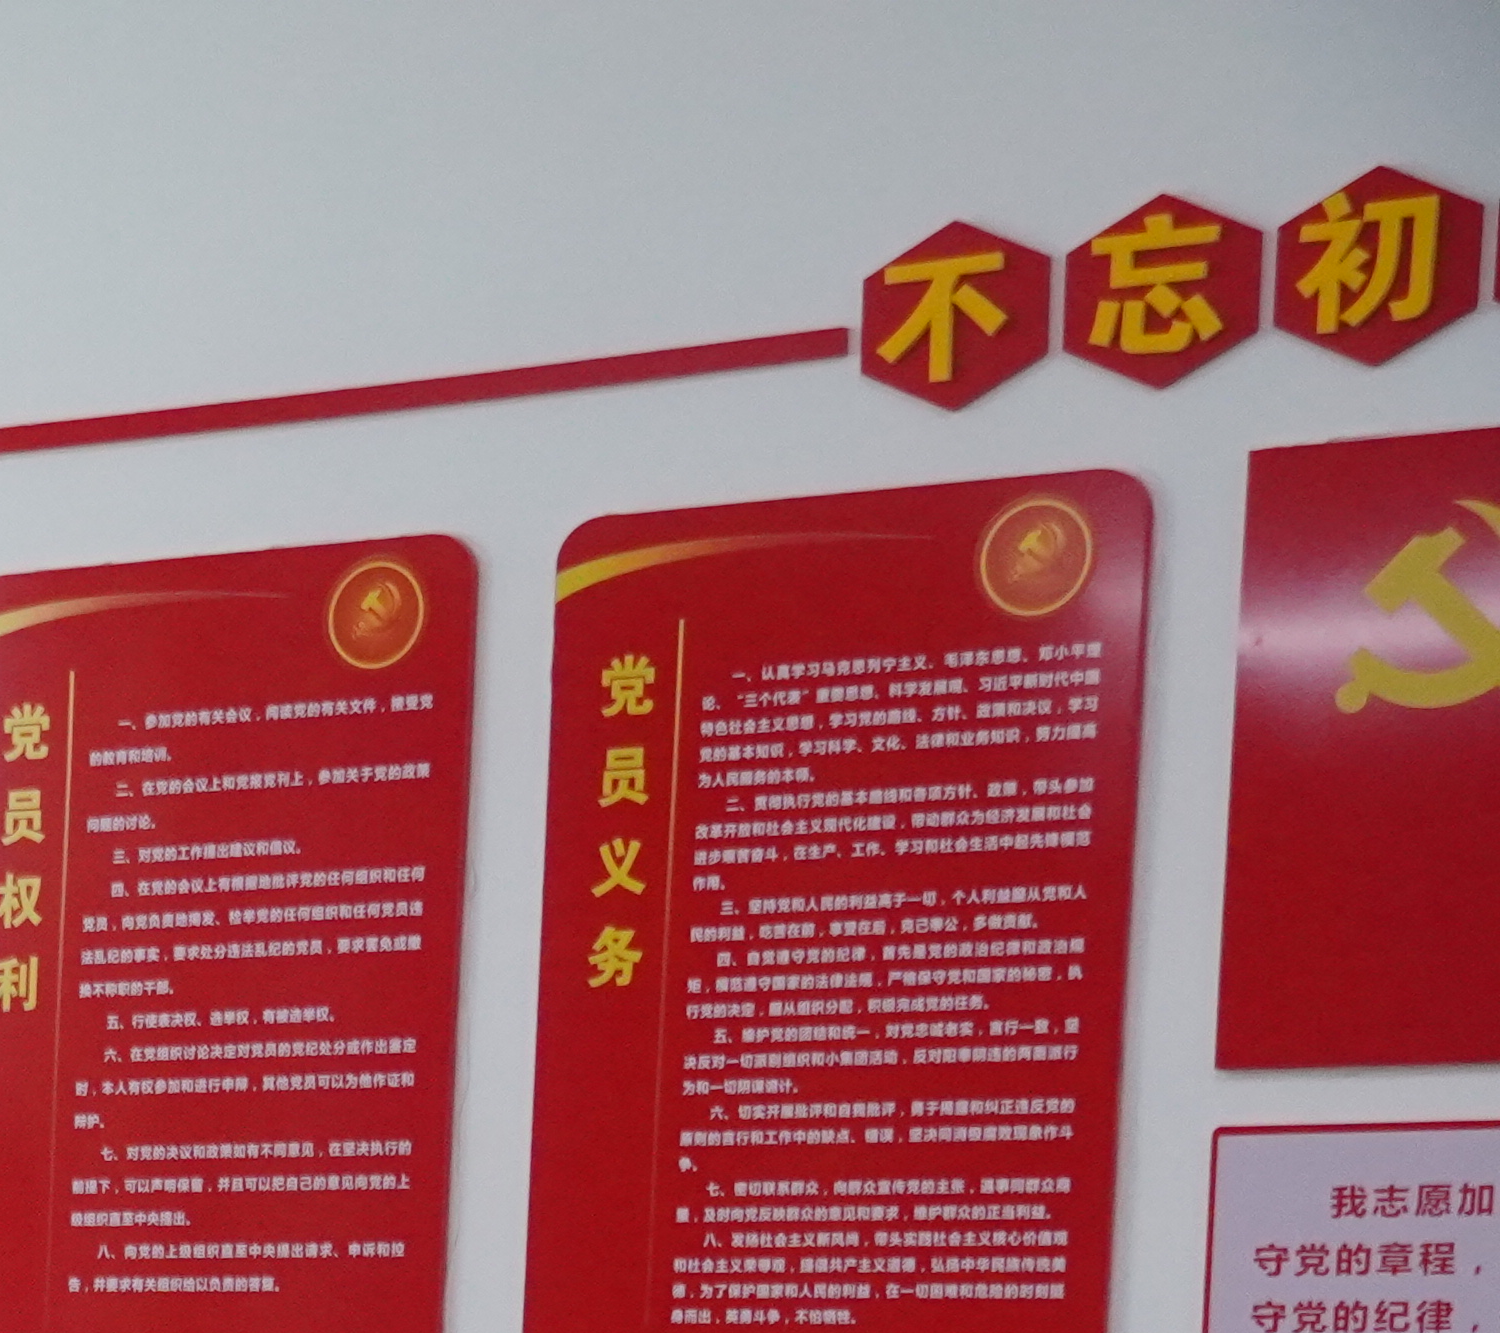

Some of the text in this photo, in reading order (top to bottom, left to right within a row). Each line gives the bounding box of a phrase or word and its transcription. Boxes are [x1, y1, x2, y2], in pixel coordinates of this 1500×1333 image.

[875, 191, 1441, 385] 不忘初
[587, 655, 655, 988] 党员义务
[1331, 1183, 1494, 1219] 我志愿加
[1253, 1242, 1483, 1277] 守党的章程，
